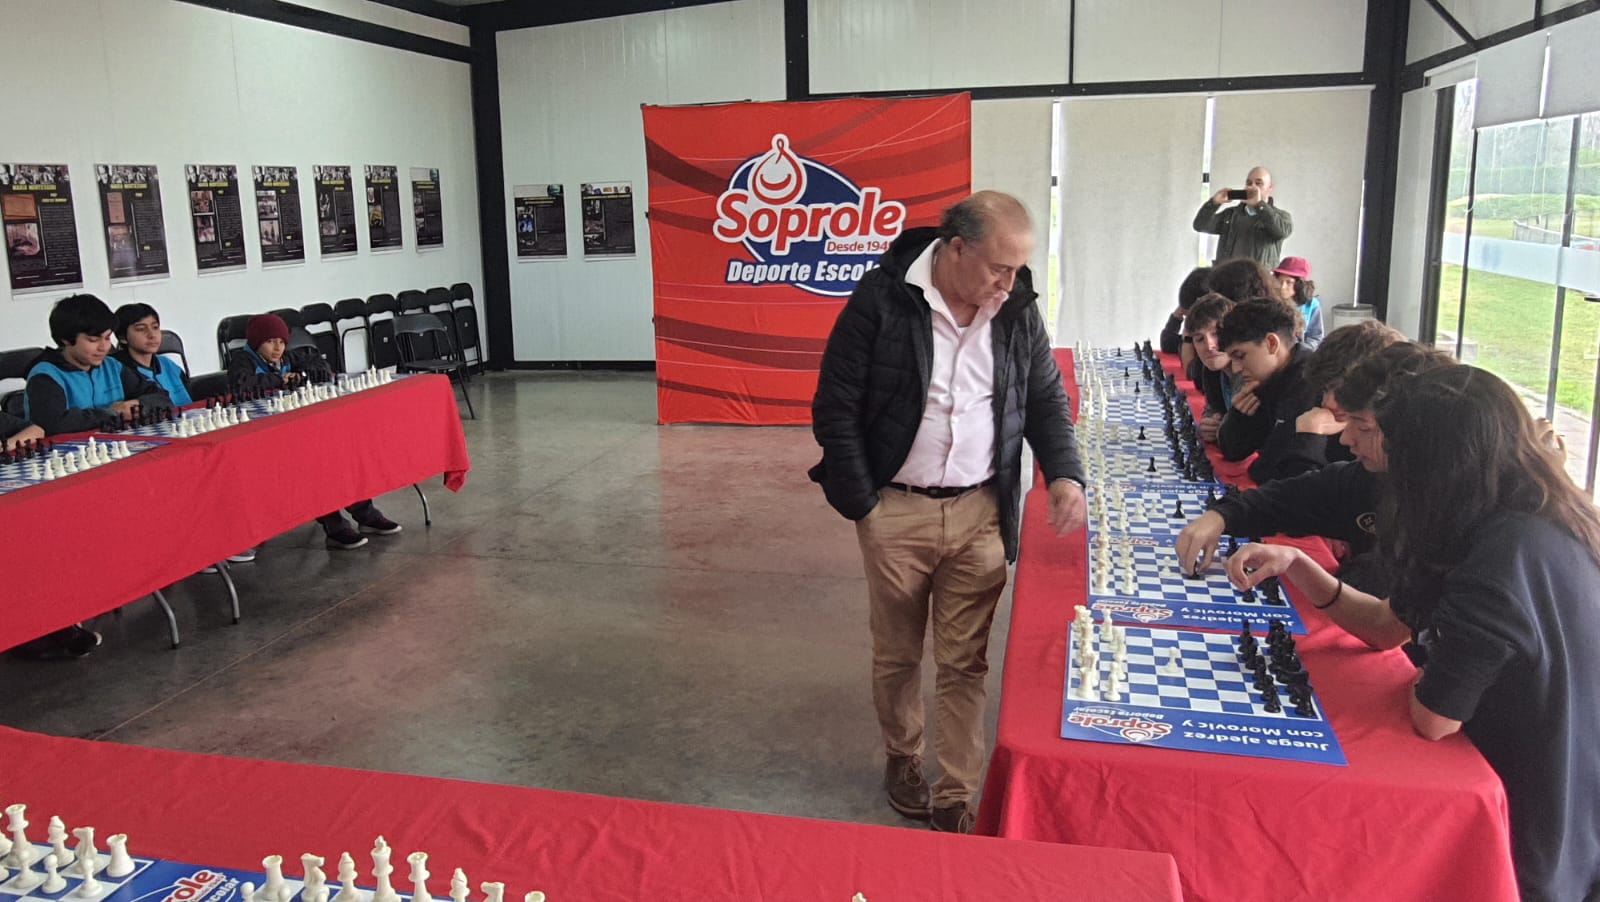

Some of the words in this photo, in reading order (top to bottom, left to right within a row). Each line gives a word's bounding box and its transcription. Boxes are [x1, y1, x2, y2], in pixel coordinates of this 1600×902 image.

[715, 190, 905, 253] Soprole
[827, 241, 865, 252] Desde
[866, 240, 893, 251] 194
[727, 260, 810, 284] Deporte
[814, 260, 880, 282] Escol
[1068, 712, 1172, 735] Soprole
[1182, 719, 1194, 728] y
[1198, 722, 1281, 736] Morovic
[1183, 731, 1261, 745] ajedrez
[1286, 729, 1324, 738] con
[1266, 738, 1329, 751] Juega
